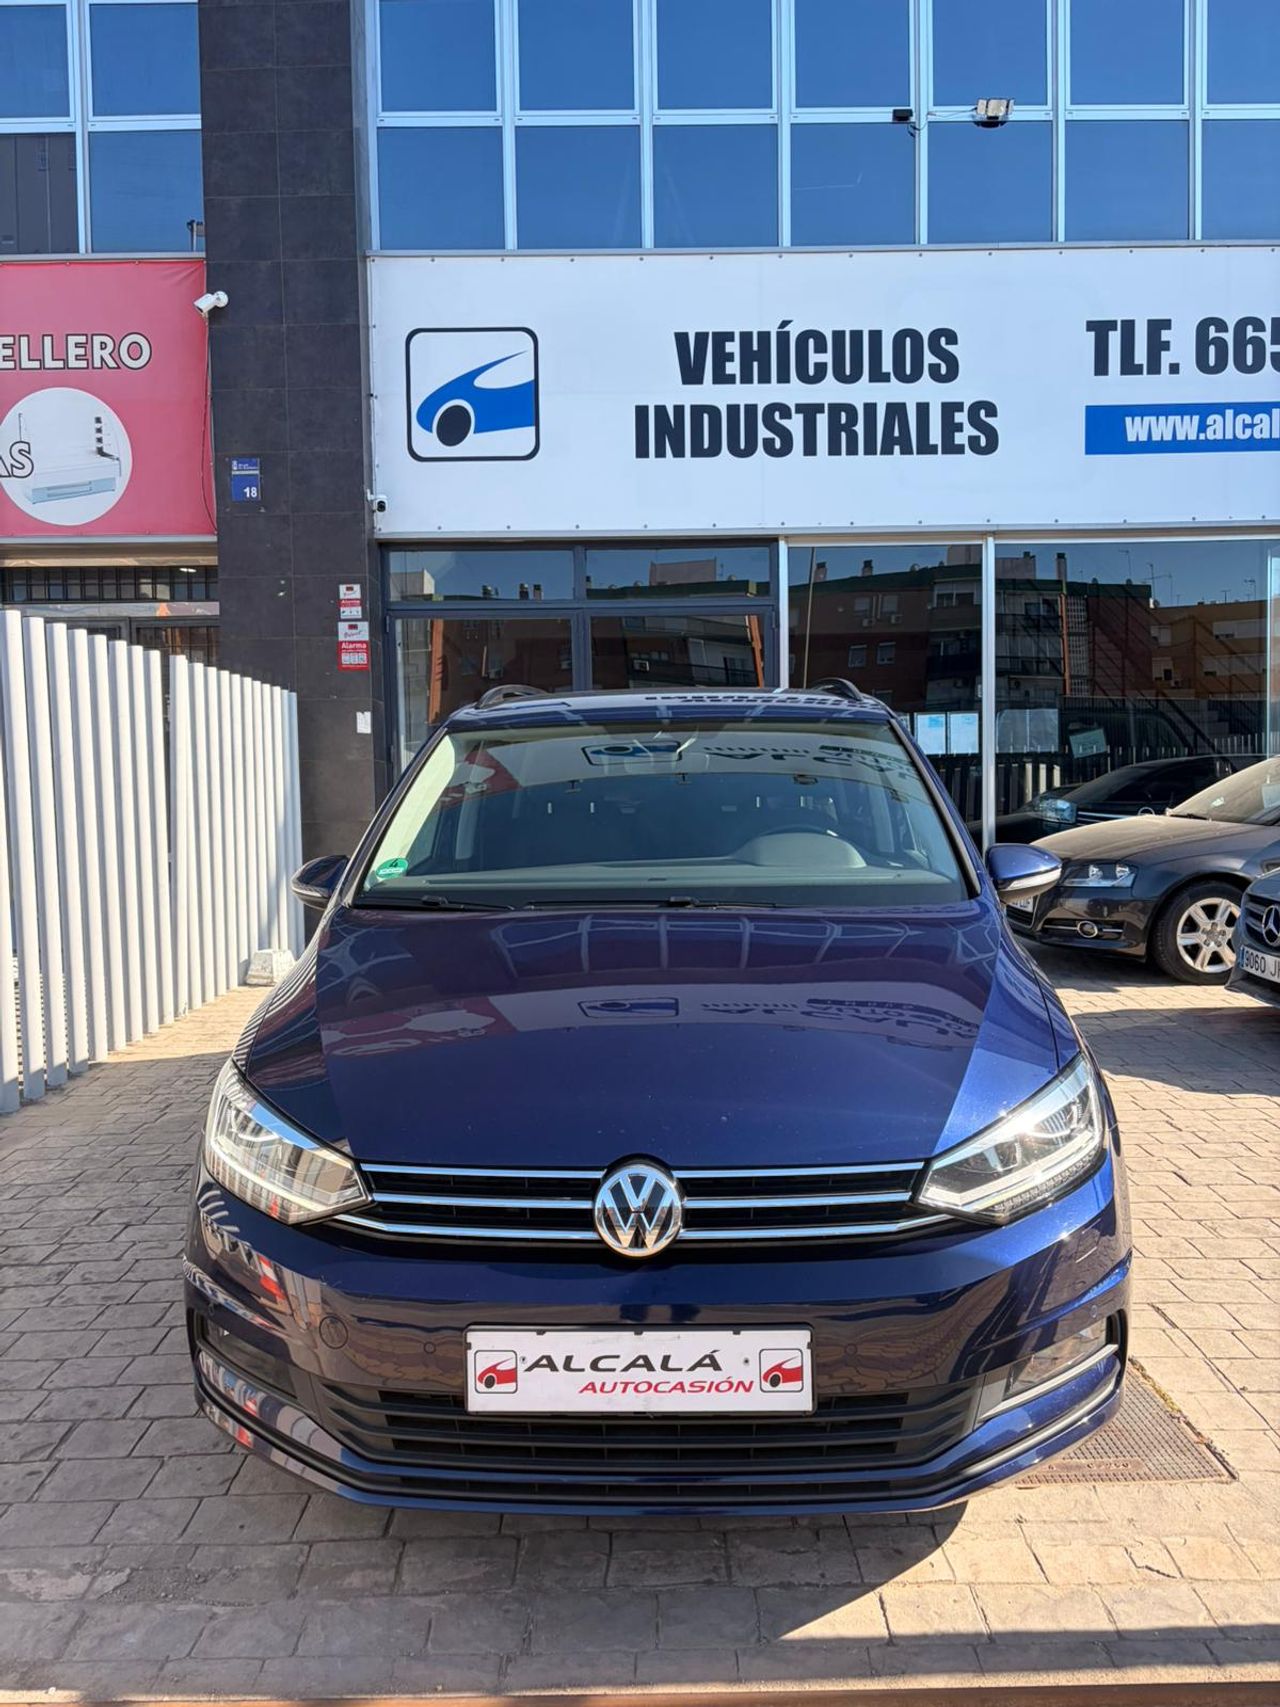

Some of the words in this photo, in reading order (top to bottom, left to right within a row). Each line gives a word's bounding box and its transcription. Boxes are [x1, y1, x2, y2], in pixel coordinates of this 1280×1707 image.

[674, 320, 960, 385] VEHÍCULOS
[1086, 319, 1180, 376] TLF.
[635, 400, 999, 459] INDUSTRIALES
[243, 486, 258, 498] 18
[523, 1350, 723, 1373] ALCALÁ
[578, 1377, 756, 1394] AUTOCASIÓN
